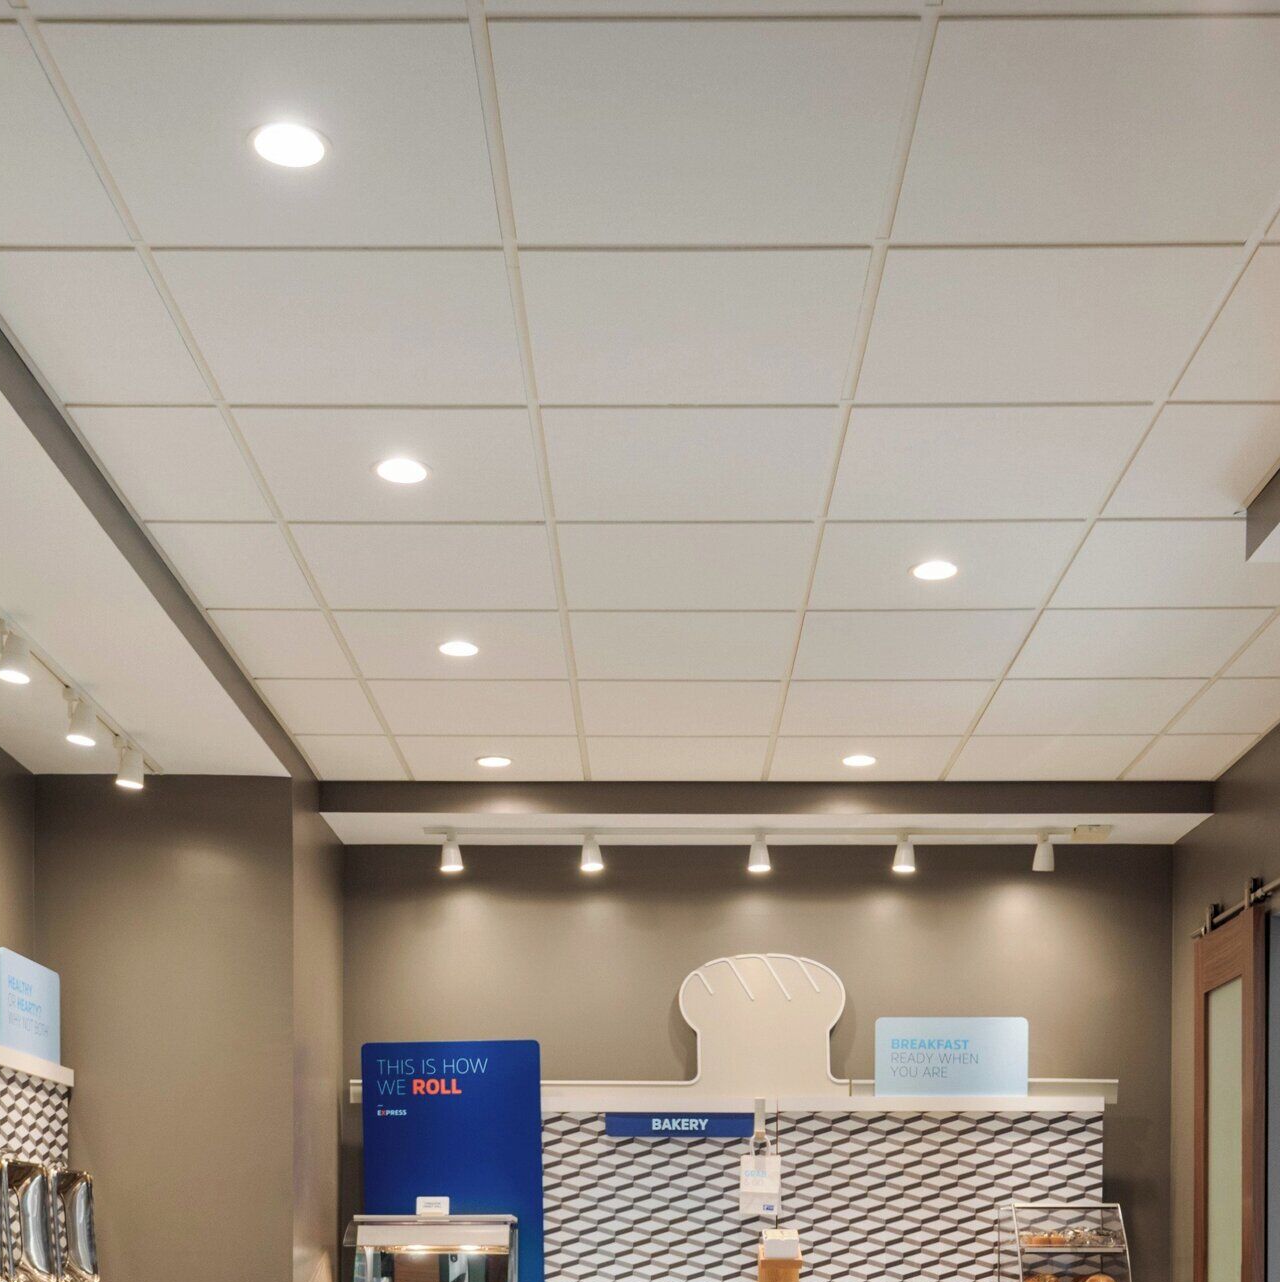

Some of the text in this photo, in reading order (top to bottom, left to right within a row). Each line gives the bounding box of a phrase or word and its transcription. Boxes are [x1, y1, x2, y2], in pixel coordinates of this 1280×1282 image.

[891, 1038, 969, 1050] BREAKFAST
[891, 1052, 979, 1064] READY WHEN
[377, 1057, 489, 1075] THIS IS HOW
[890, 1066, 948, 1078] YOU ARE
[377, 1078, 462, 1096] WE ROLL
[377, 1109, 407, 1117] EXPRESS
[651, 1118, 709, 1131] BAKERY
